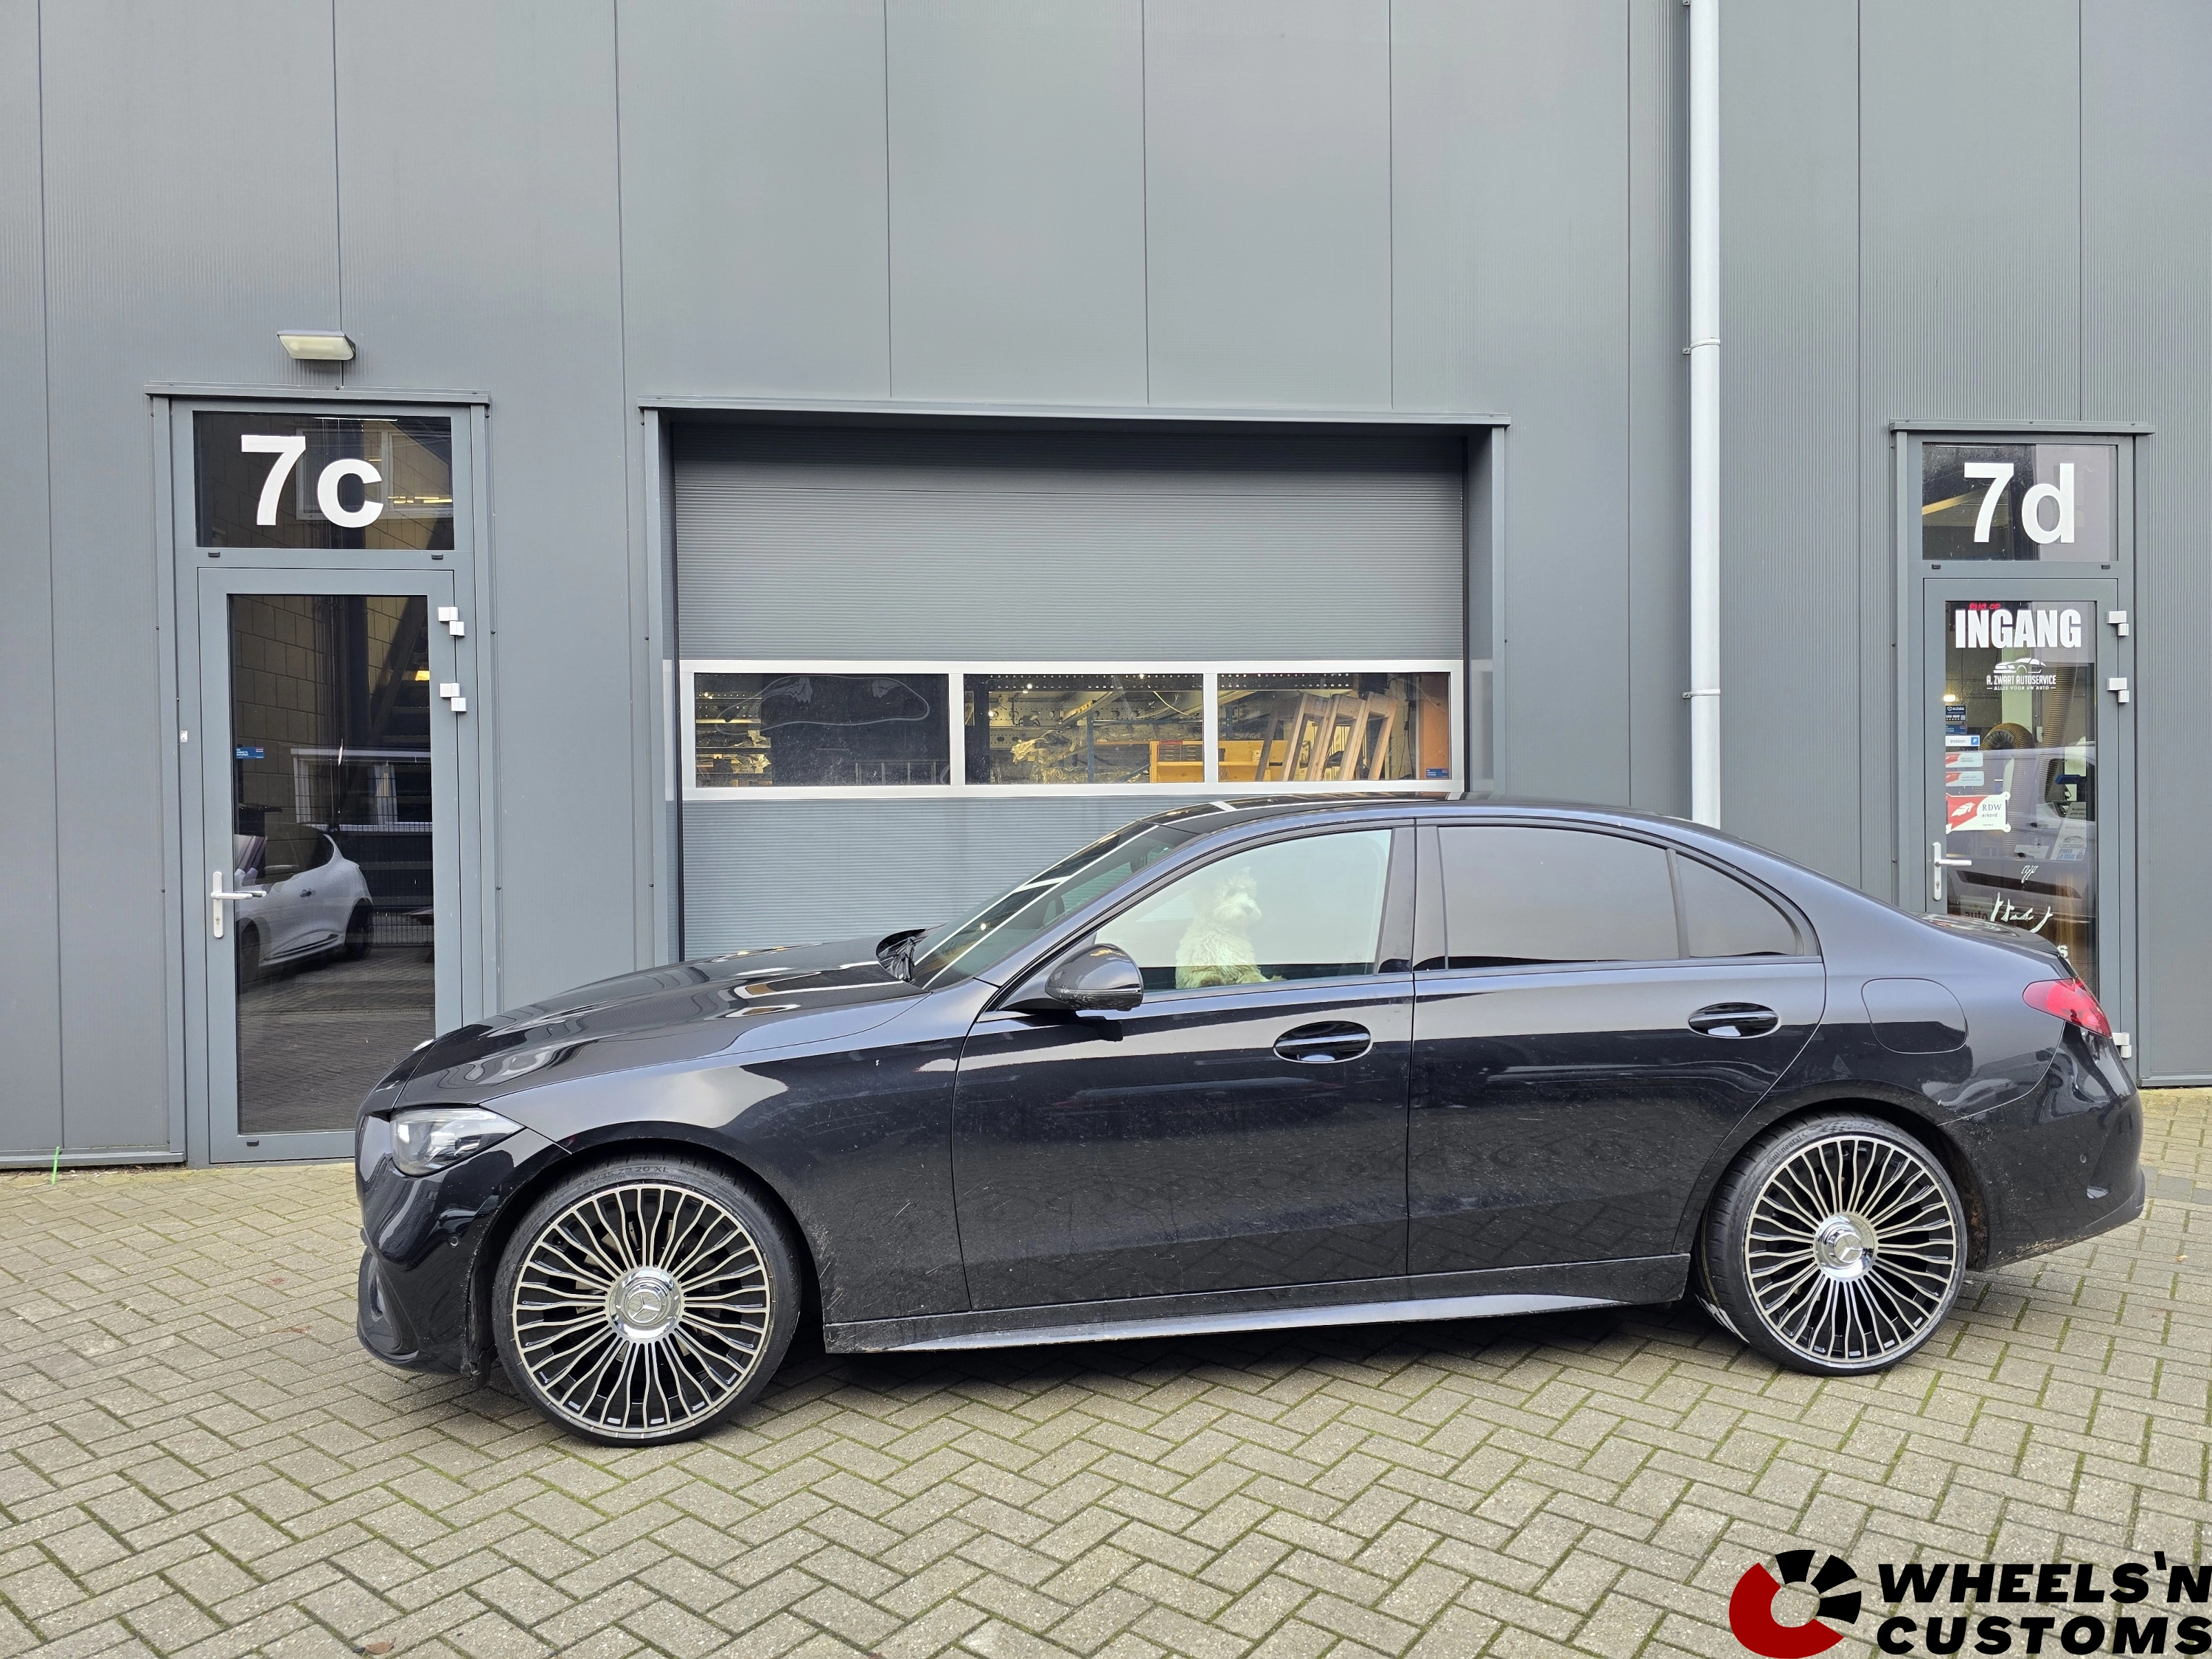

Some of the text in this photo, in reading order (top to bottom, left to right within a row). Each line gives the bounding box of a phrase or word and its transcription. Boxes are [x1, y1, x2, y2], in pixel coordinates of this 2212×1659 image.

[241, 434, 383, 528] 7c
[1964, 462, 2075, 544] 7d
[1955, 609, 2081, 649] INGANG
[1994, 675, 2014, 685] ZWART
[2016, 675, 2056, 685] AUTOSERVICE
